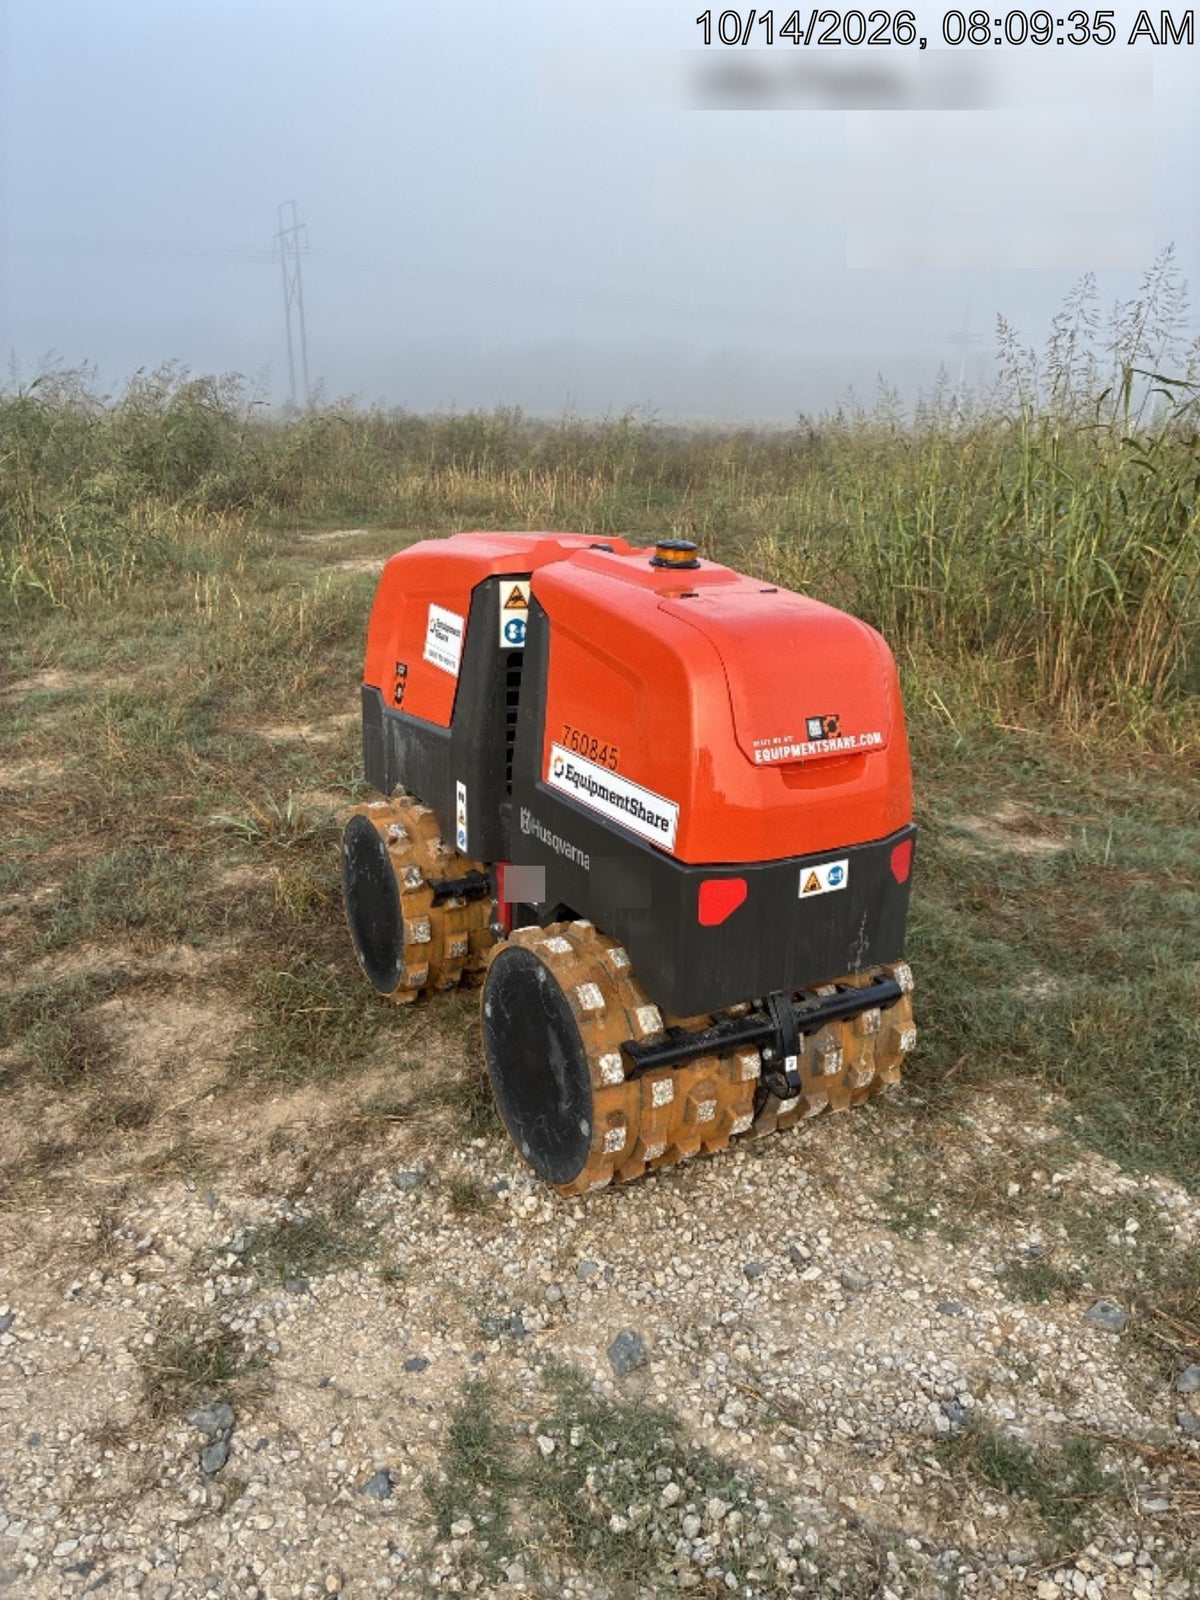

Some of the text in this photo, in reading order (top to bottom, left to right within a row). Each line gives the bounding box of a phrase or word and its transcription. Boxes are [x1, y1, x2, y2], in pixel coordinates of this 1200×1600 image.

[562, 725, 619, 771] 760845
[754, 732, 883, 763] EQUIPMENTSHARE.COM
[564, 763, 670, 833] EquipmentShare
[530, 816, 590, 871] Husqvarna
